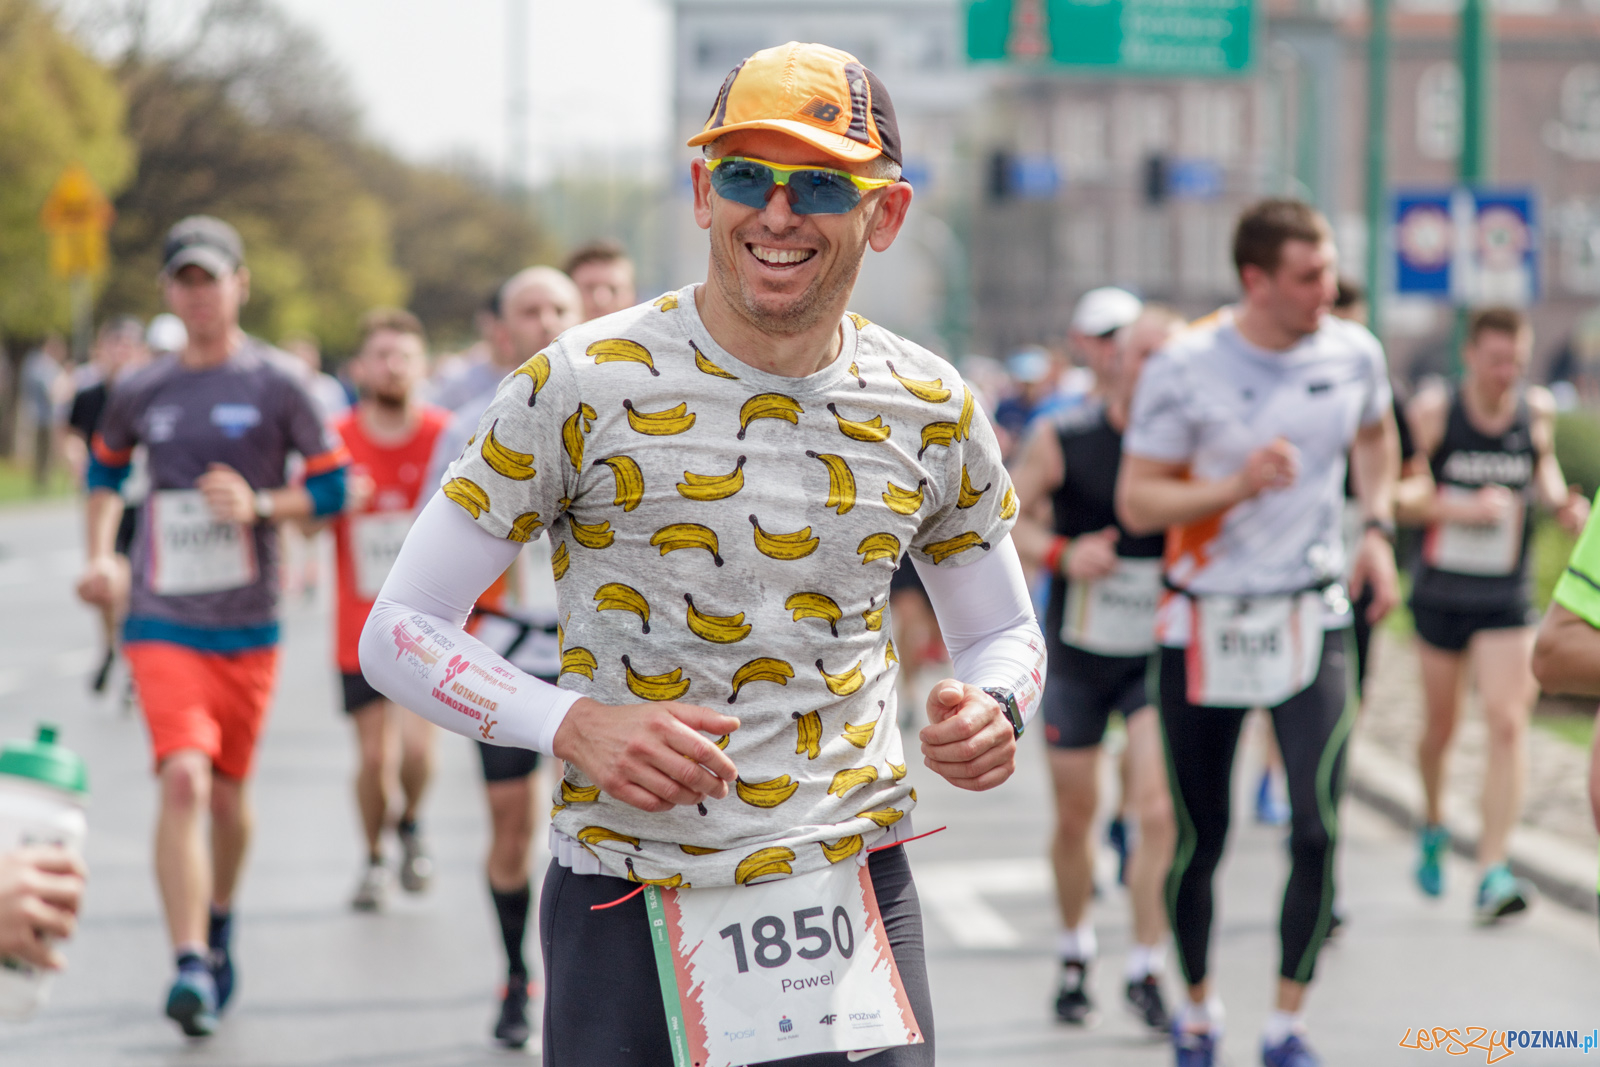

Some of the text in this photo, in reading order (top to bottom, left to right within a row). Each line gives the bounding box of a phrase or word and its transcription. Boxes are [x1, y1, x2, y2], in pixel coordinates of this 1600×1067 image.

[431, 687, 482, 720] GORZOWSKI
[450, 681, 498, 712] DUATHLON
[718, 905, 855, 974] 1850
[781, 970, 835, 993] Pawel
[819, 1014, 838, 1025] 4F
